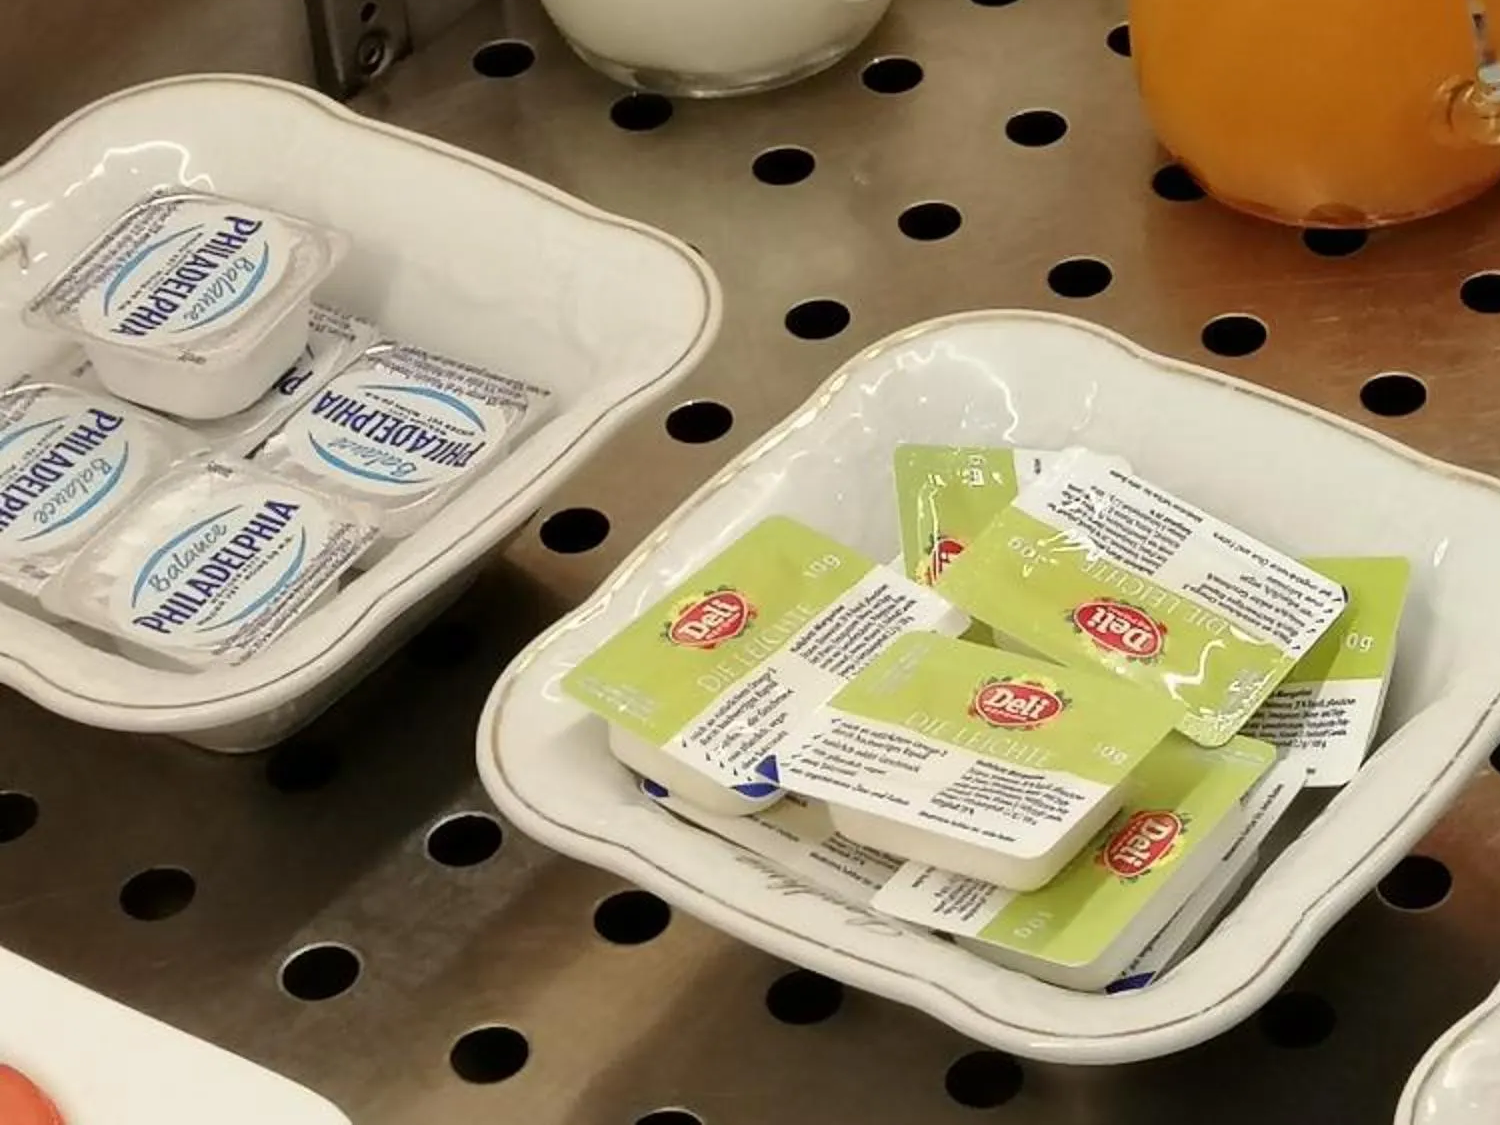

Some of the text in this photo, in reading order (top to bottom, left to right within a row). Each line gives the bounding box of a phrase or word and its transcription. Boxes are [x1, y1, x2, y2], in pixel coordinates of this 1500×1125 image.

[110, 215, 262, 338] PHILADELPHIA
[311, 389, 486, 468] PHILADELPHIA
[0, 408, 125, 531] PHILADELPH
[133, 499, 300, 634] PHILADELPHIA
[149, 520, 229, 593] Balance
[679, 599, 742, 640] Deli
[1087, 607, 1153, 651] Deli
[987, 687, 1049, 719] Deli
[1112, 818, 1173, 868] Deli
